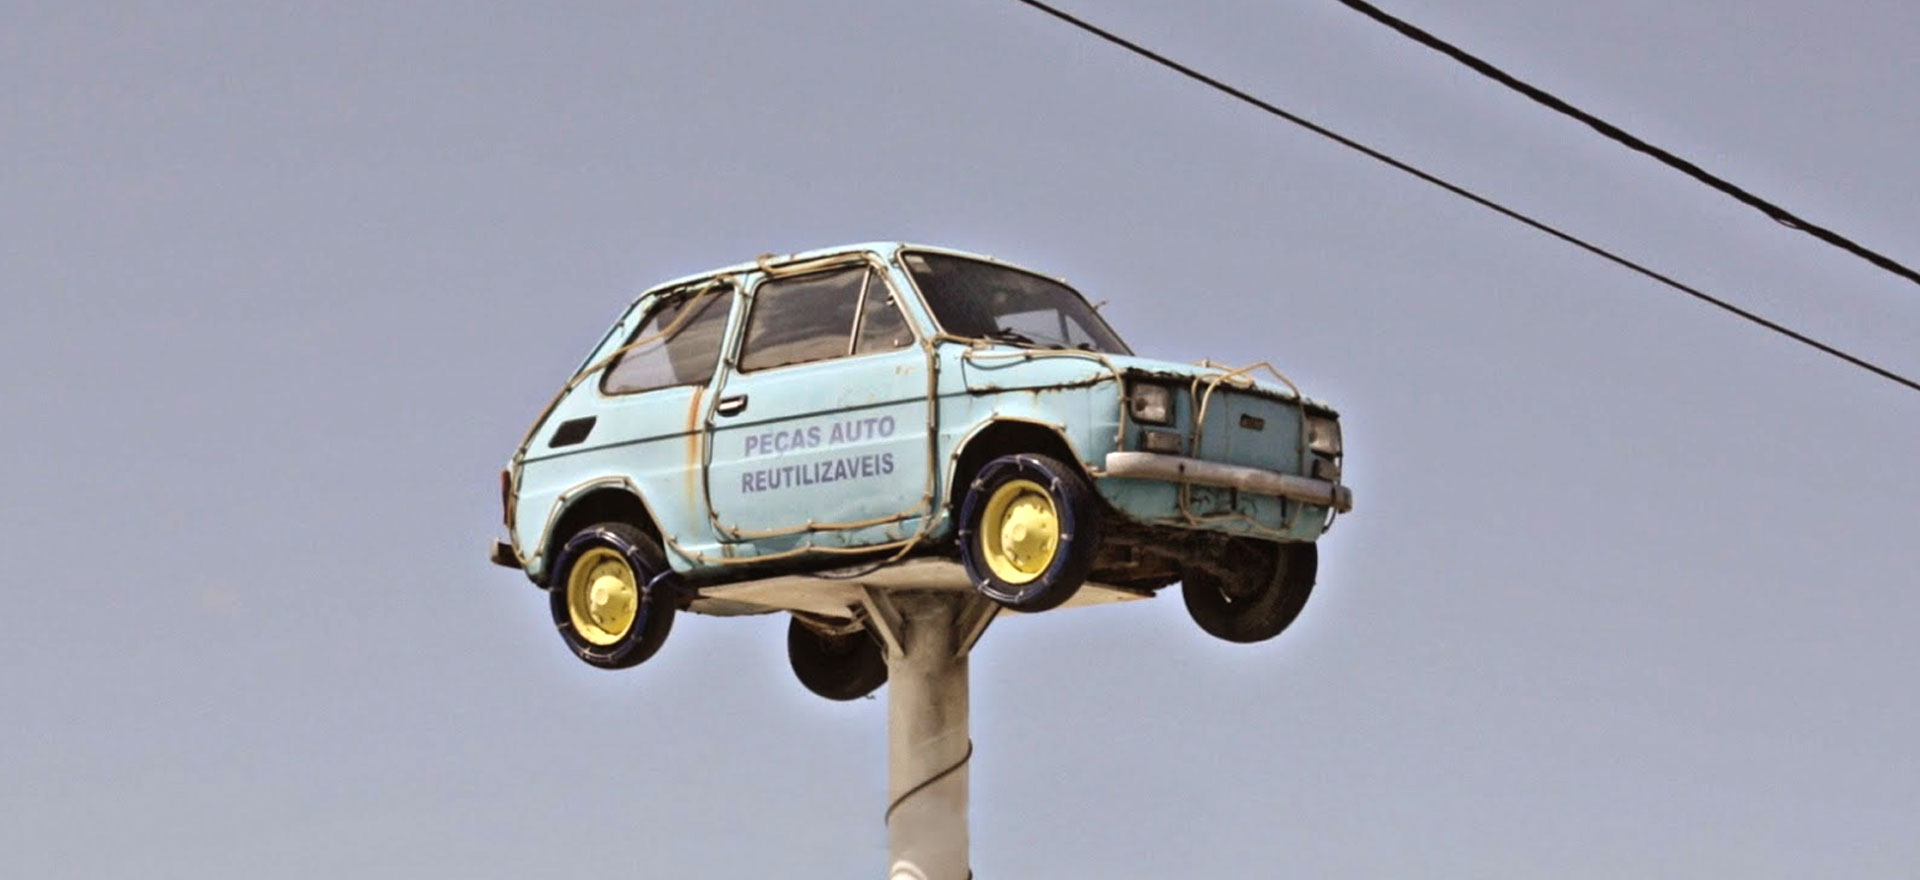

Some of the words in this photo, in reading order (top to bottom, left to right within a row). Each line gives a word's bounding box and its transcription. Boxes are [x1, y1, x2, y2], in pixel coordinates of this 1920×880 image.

[745, 426, 821, 457] PEÇAS
[829, 416, 895, 444] AUTO
[742, 453, 895, 493] REUTILIZAVEIS
